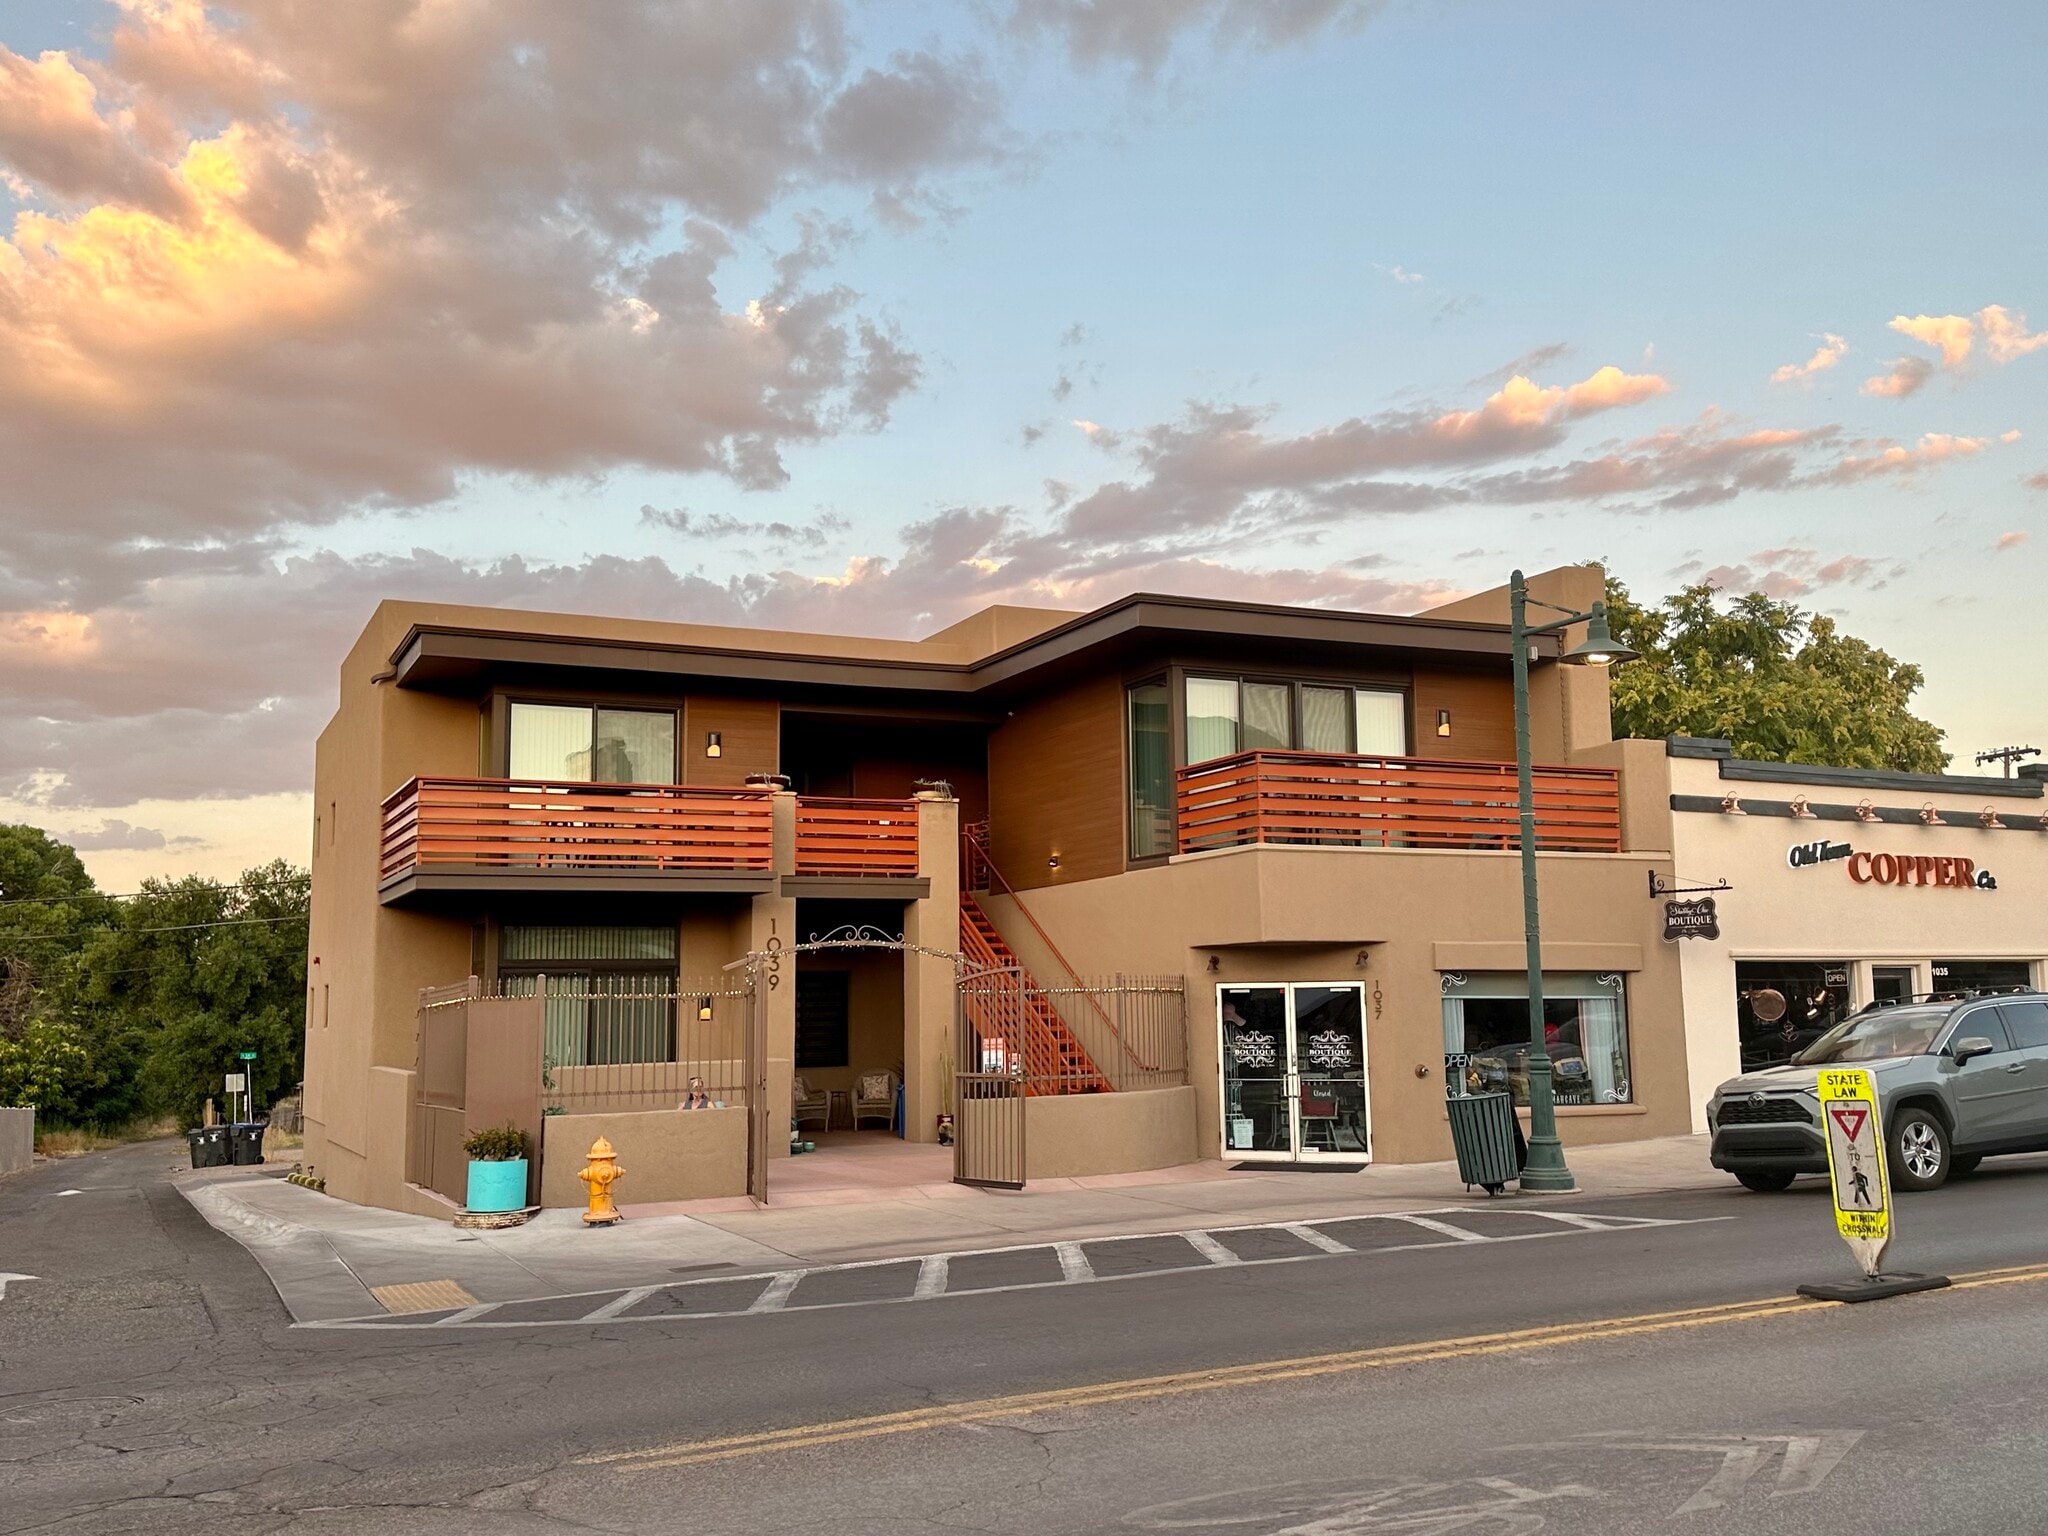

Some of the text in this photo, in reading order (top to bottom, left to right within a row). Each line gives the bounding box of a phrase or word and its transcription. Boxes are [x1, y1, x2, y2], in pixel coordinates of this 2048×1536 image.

[1789, 843, 1818, 867] Old
[1819, 840, 1854, 862] Town
[1848, 851, 1977, 888] COPPER
[1668, 915, 1713, 926] BOUTIQUE
[766, 917, 782, 991] 1039
[1931, 967, 1949, 976] 1035
[1827, 973, 1846, 983] OPEN
[1373, 979, 1383, 1020] 1037
[1826, 1074, 1862, 1086] STATE
[1834, 1087, 1857, 1098] LAW
[1849, 1152, 1861, 1161] TO
[1850, 1214, 1876, 1222] WITHIN
[1842, 1224, 1885, 1234] CROSSWALK
